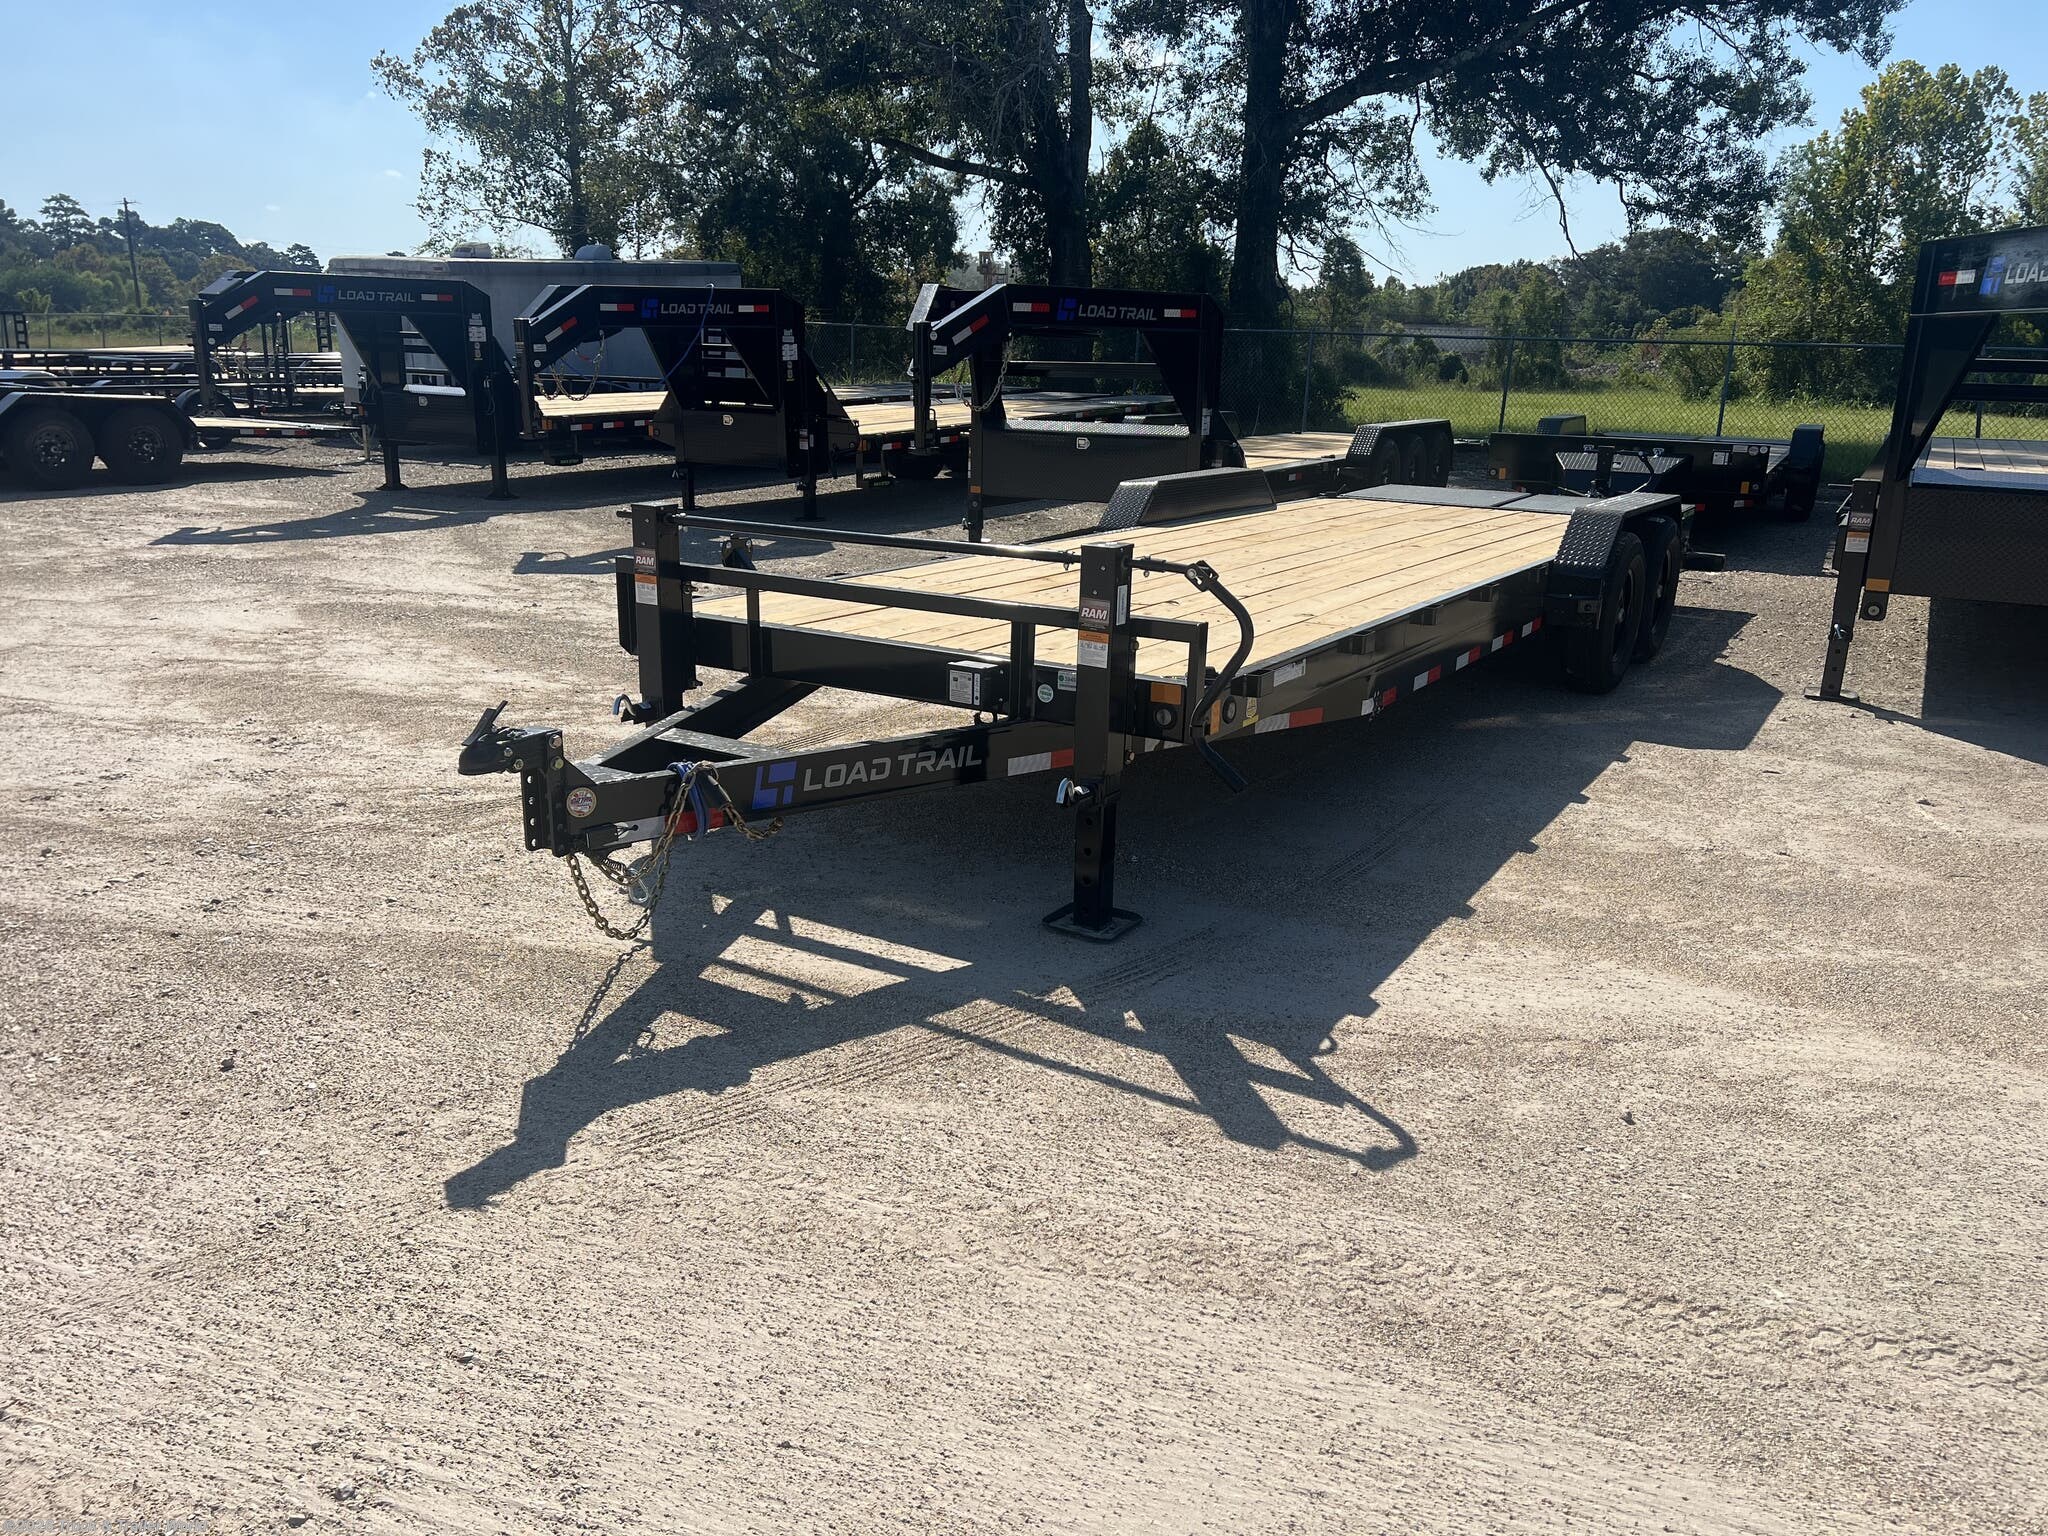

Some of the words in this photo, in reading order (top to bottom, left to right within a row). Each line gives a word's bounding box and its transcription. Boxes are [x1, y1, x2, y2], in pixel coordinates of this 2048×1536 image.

[338, 289, 375, 301] LOAD
[376, 291, 415, 303] TRAIL
[660, 303, 696, 314] LOAD
[698, 303, 734, 315] TRAIL
[1078, 304, 1117, 318] LOAD
[1119, 306, 1157, 321] TRAIL
[635, 555, 655, 566] RAM
[1081, 607, 1108, 620] RAM
[803, 756, 892, 792] LOAD
[898, 744, 983, 776] TRAIL
